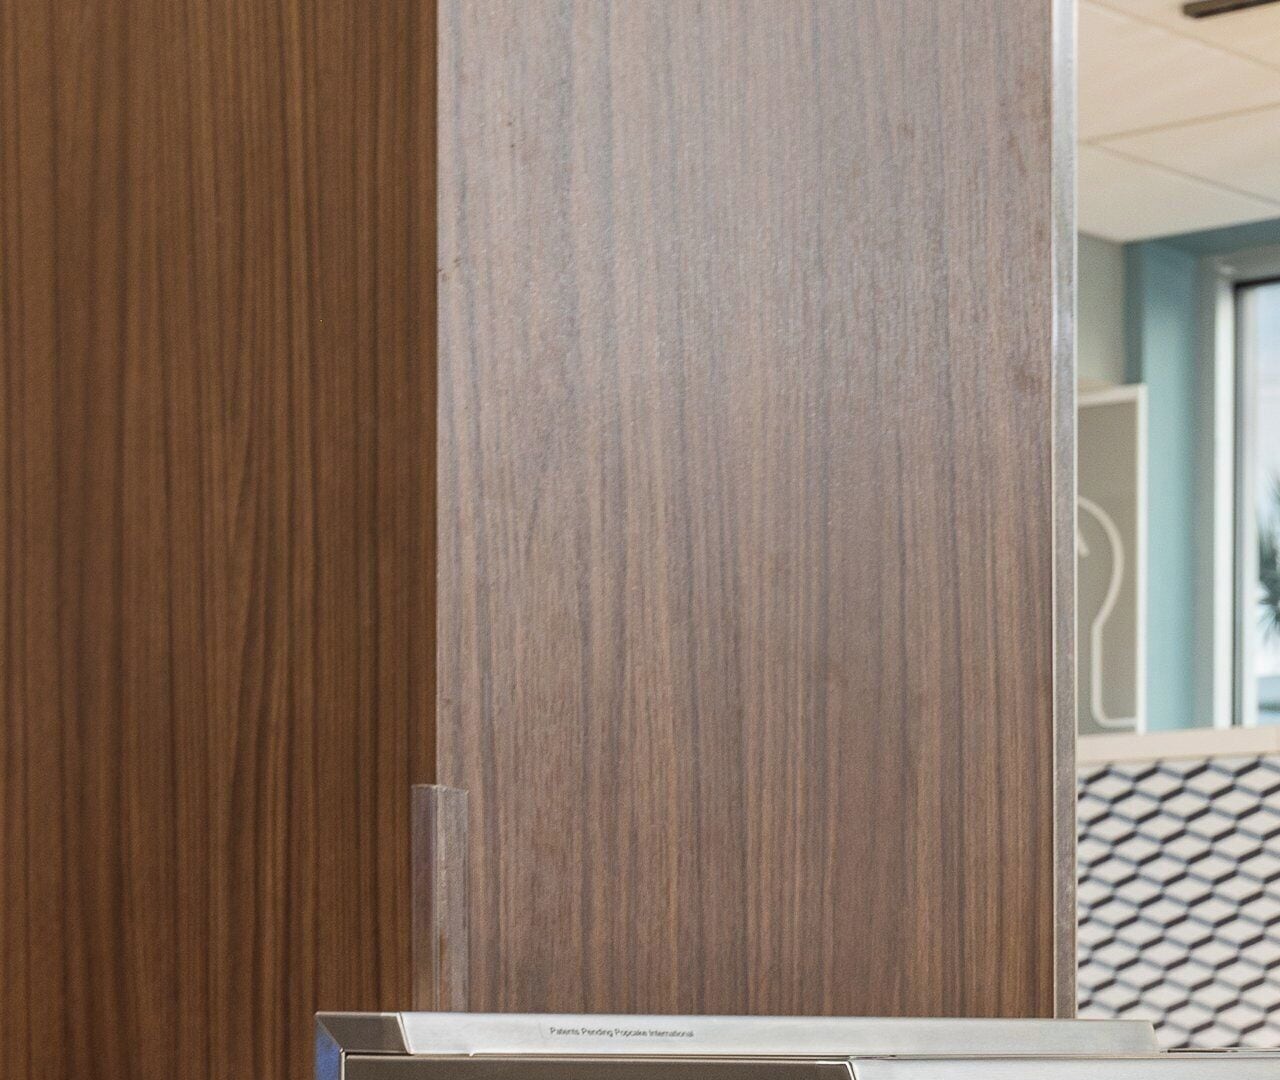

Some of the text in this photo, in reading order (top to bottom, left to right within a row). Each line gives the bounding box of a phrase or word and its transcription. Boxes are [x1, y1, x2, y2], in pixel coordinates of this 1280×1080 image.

[550, 1027, 580, 1036] Patents
[581, 1027, 613, 1037] Pending
[649, 1029, 694, 1038] International
